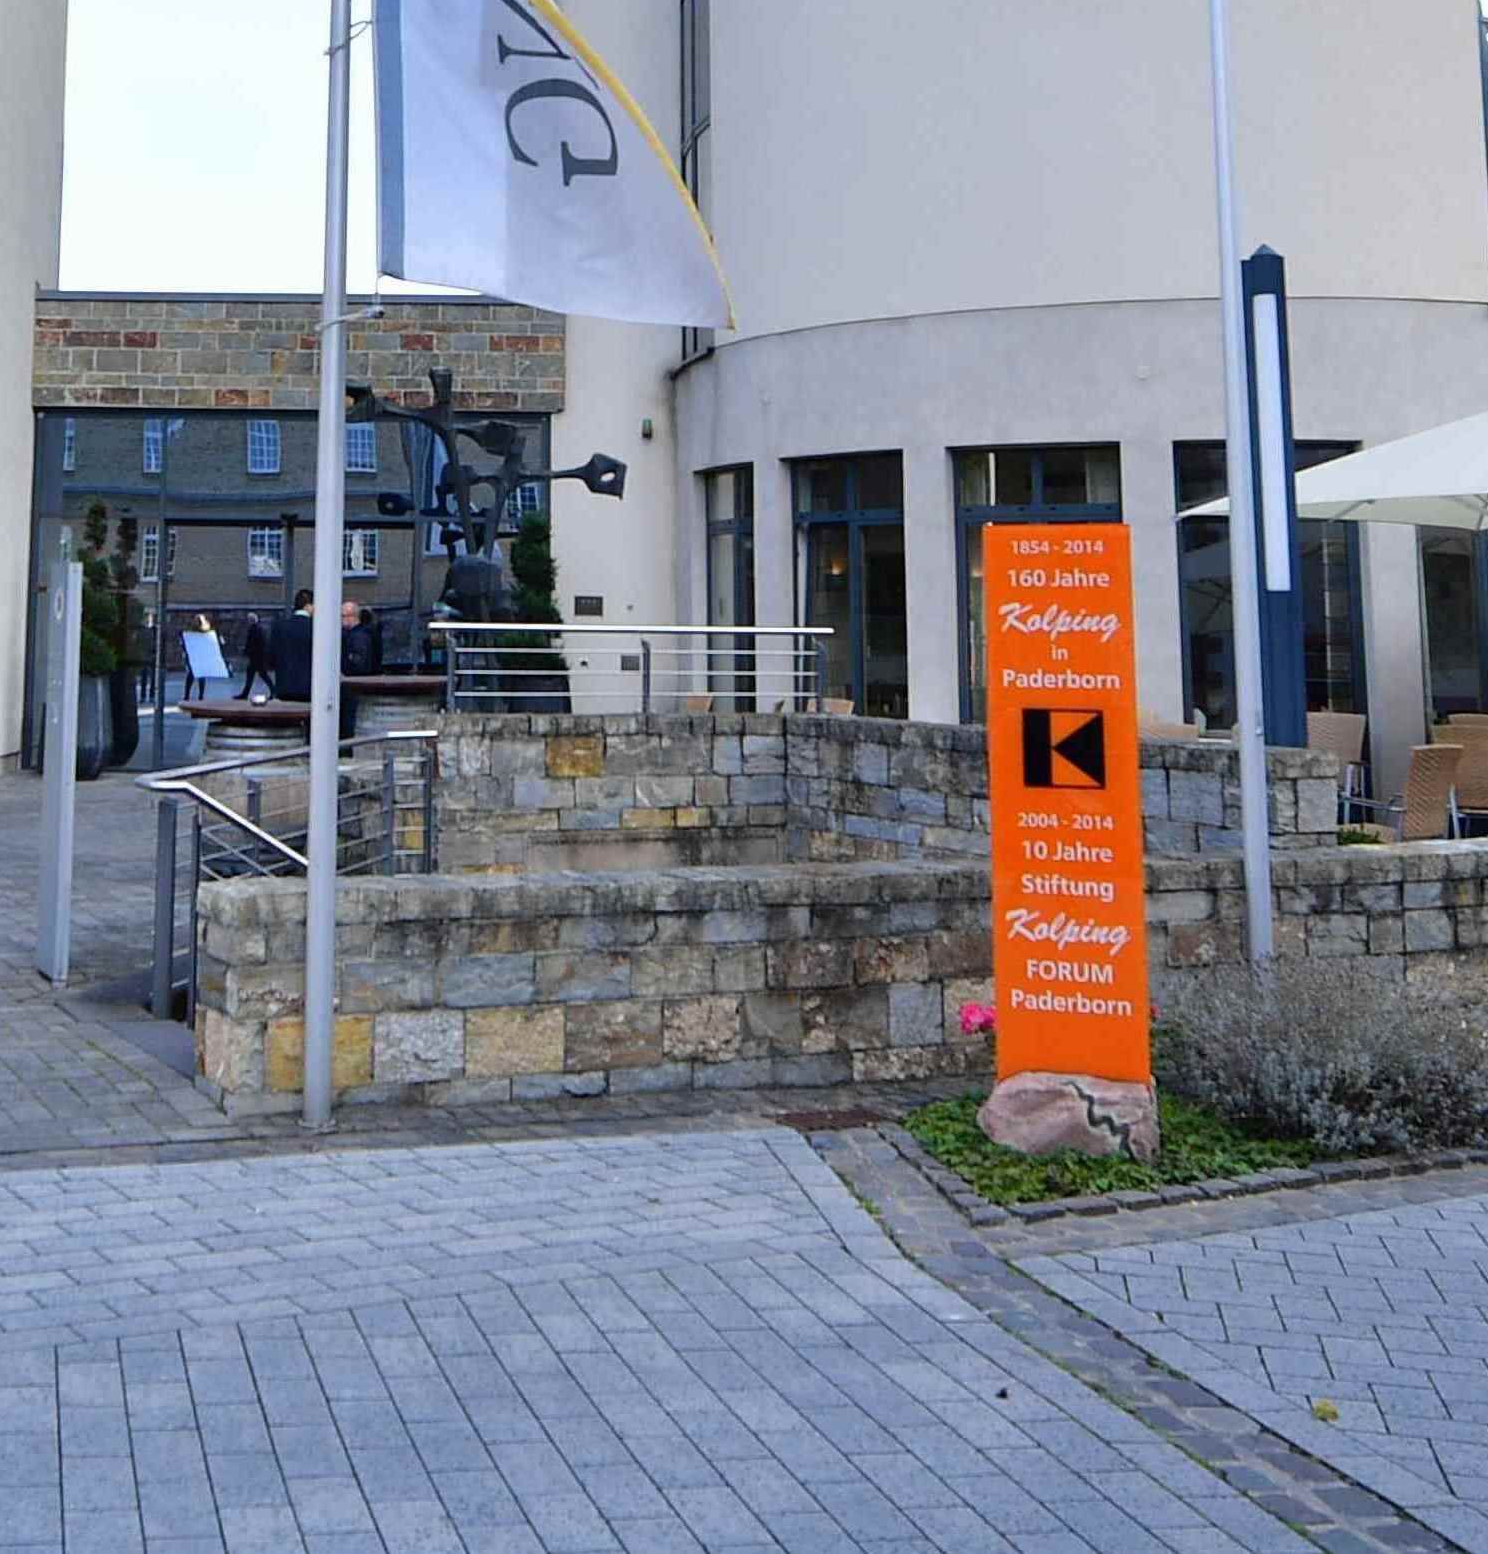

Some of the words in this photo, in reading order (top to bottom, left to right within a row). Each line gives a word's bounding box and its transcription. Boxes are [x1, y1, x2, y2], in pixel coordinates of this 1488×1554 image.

[1011, 540, 1049, 555] 1854
[1064, 540, 1104, 554] 2014
[1008, 569, 1046, 587] 160
[1050, 569, 1110, 588] Jahre
[998, 602, 1120, 642] Kolping
[1051, 644, 1068, 660] in
[1002, 669, 1120, 689] Paderborn
[1017, 812, 1059, 828] 2004
[1071, 814, 1114, 830] 2014
[1021, 840, 1048, 860] 10
[1053, 841, 1113, 863] Jahre
[1021, 874, 1114, 902] Stiftung
[1005, 908, 1131, 956] Kolping
[1026, 959, 1114, 983] FORUM
[1011, 989, 1132, 1016] Paderborn
